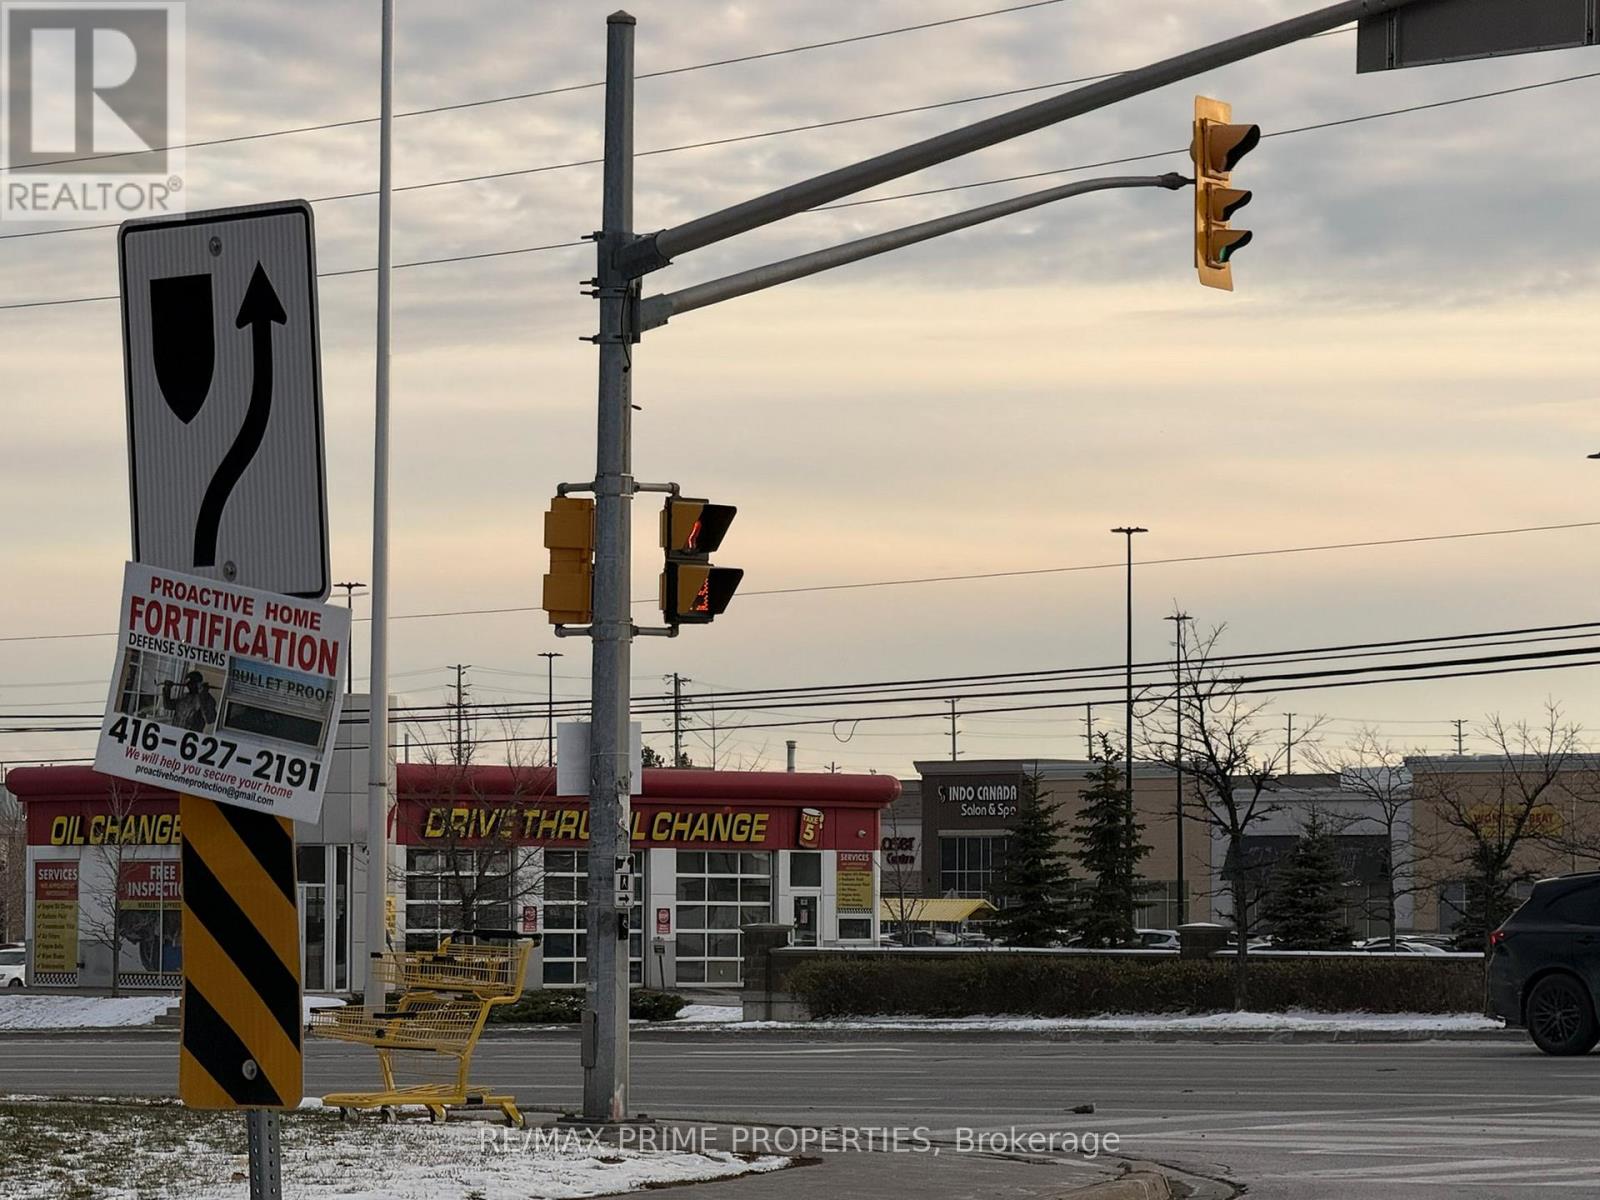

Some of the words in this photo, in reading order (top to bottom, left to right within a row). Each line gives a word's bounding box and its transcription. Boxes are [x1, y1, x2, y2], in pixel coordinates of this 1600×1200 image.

[150, 575, 255, 617] PROACTIVE
[265, 601, 321, 631] HOME
[128, 595, 339, 677] FORTIFICATION
[128, 632, 175, 655] DEFENSE
[177, 643, 226, 667] SYSTEMS
[232, 668, 283, 692] BULLET
[287, 680, 333, 703] PROOF
[108, 716, 321, 792] 416-627-2191
[125, 746, 140, 760] We
[141, 751, 159, 765] will
[160, 755, 181, 772] help
[182, 762, 201, 776] you
[203, 769, 238, 785] secure
[238, 777, 262, 792] your
[264, 783, 293, 799] home
[135, 764, 274, 806] proactivehomeprotection@gmail.com
[949, 785, 974, 800] INDO
[977, 784, 1017, 800] CANADA
[425, 807, 517, 839] DRIVE
[652, 811, 769, 842] CHANGE
[802, 813, 819, 825] TAKE
[961, 803, 987, 816] Salon
[988, 803, 997, 816] &
[997, 803, 1017, 819] Spa
[51, 815, 85, 845] OIL
[89, 814, 181, 845] CHANGE
[803, 823, 815, 841] 5
[150, 865, 176, 880] FREE
[840, 853, 870, 862] SERVICES
[38, 868, 78, 880] SERVICES
[128, 881, 182, 897] INSPECTI
